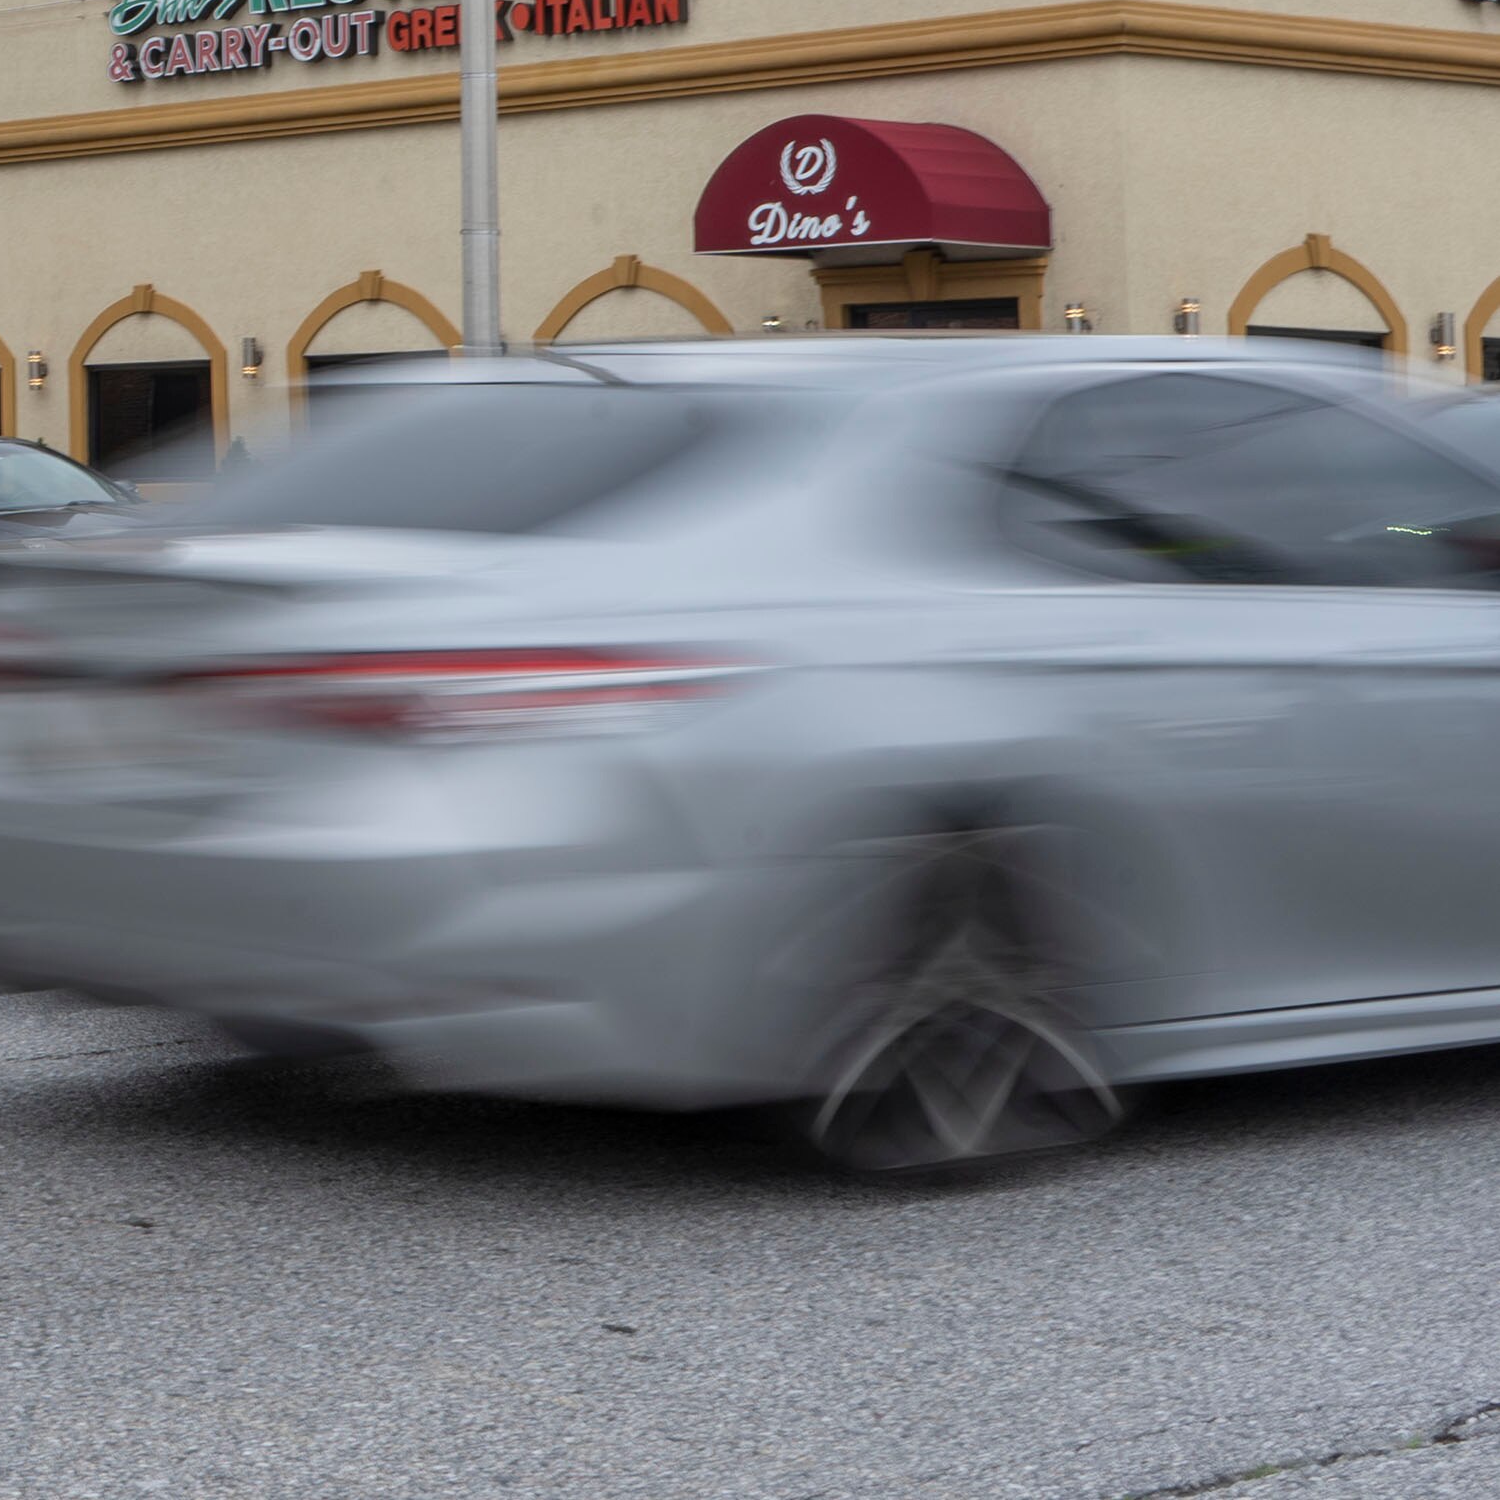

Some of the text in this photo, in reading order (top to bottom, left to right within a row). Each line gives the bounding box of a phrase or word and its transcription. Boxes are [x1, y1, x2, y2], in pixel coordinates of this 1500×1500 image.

[107, 43, 134, 82] &
[139, 10, 376, 79] CARRY-OUT
[794, 146, 824, 181] D
[747, 195, 871, 245] Dino's
